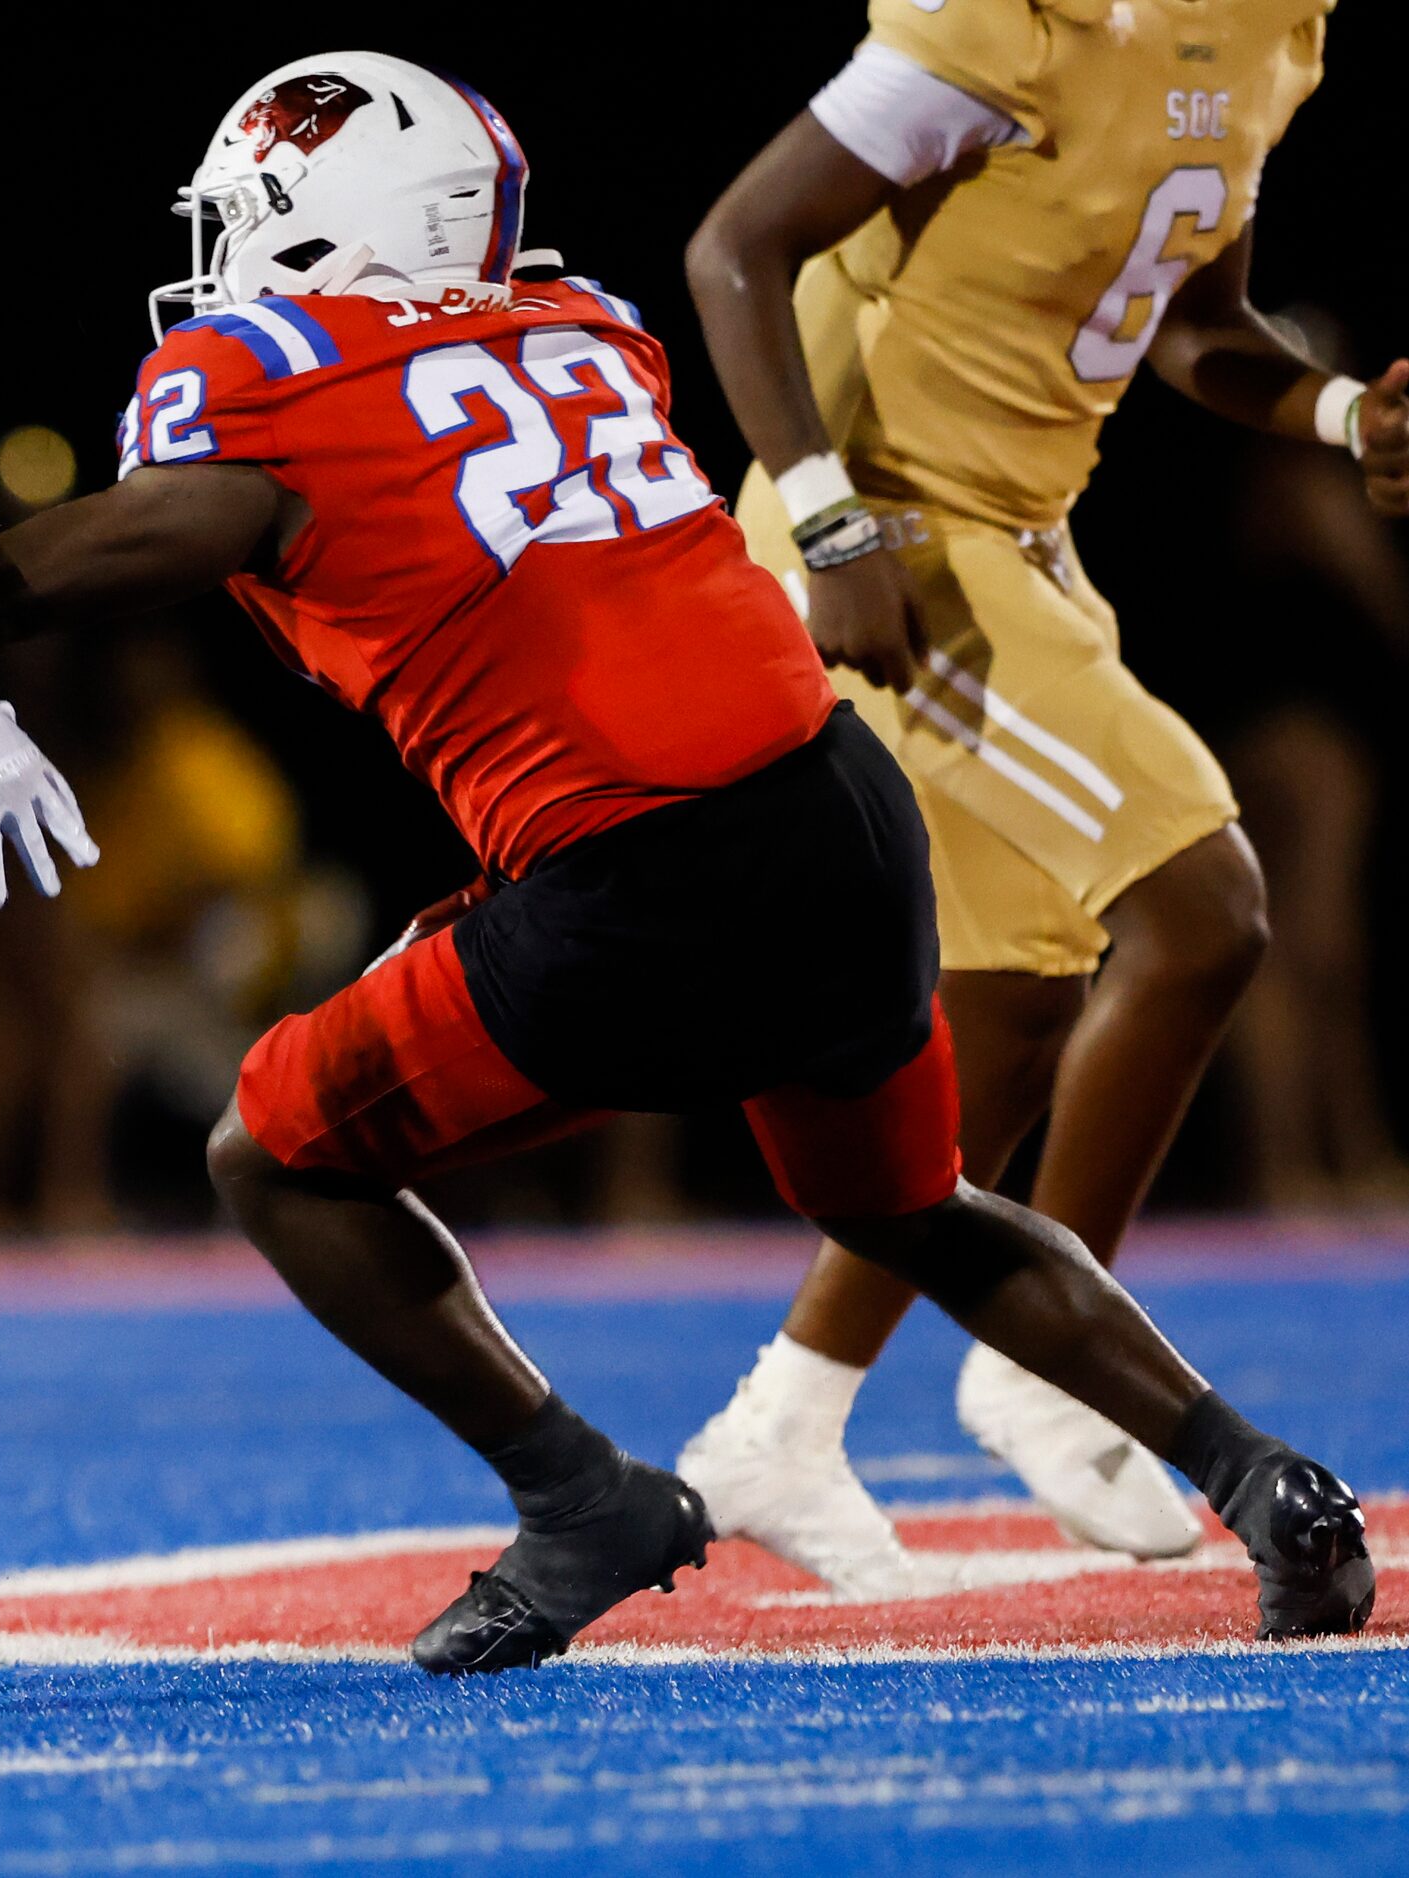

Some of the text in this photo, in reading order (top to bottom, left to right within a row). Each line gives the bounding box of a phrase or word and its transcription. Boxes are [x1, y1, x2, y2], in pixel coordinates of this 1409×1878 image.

[1166, 89, 1229, 139] SOC
[1067, 165, 1227, 382] 6
[400, 323, 727, 577] 22
